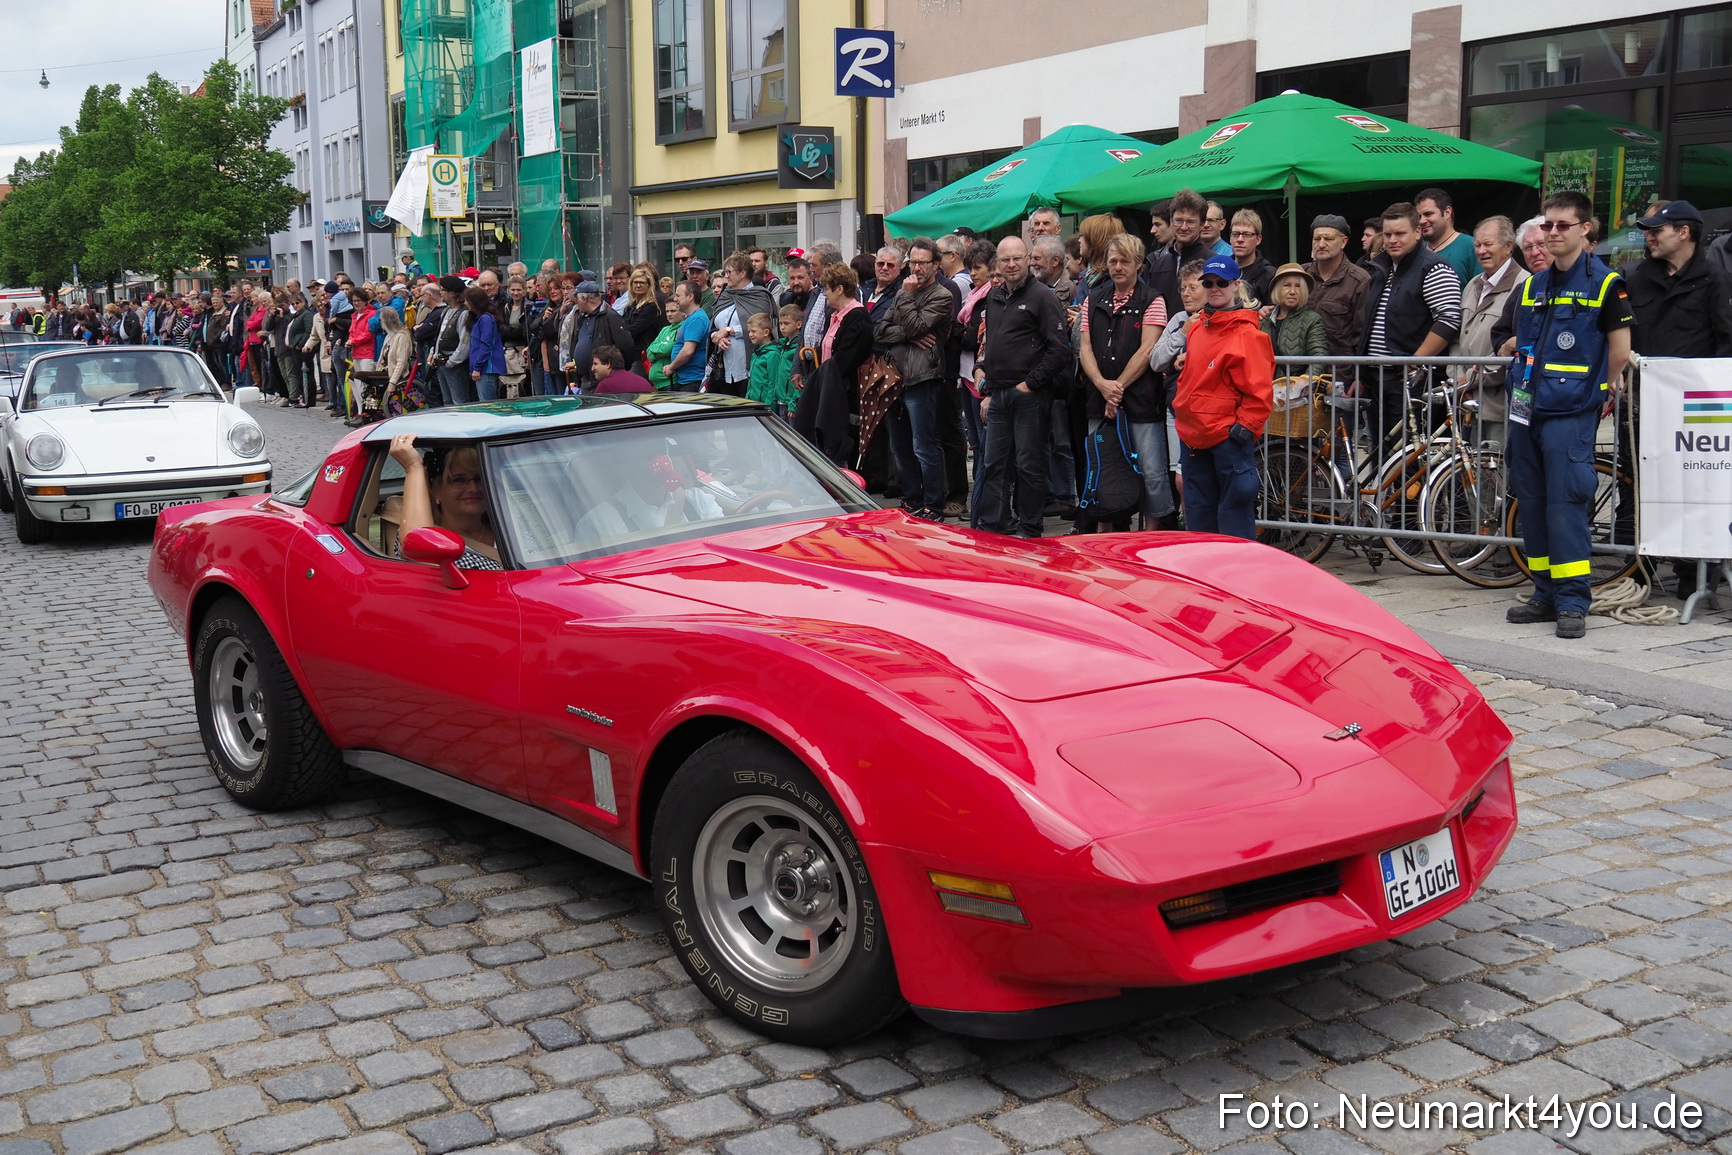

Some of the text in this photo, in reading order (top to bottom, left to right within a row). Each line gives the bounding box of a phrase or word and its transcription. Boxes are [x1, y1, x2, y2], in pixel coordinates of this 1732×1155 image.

[900, 110, 946, 129] Unterer Markt 15
[1351, 142, 1463, 155] Lammsbräu
[1353, 135, 1433, 144] Neumarkter
[801, 143, 821, 169] G2
[439, 165, 451, 180] H
[1132, 154, 1236, 178] Lammsbräu
[1550, 168, 1570, 176] Wald-
[54, 399, 68, 407] 146
[1675, 430, 1732, 453] Neu
[1683, 460, 1732, 470] einkaufe
[125, 504, 141, 517] FO
[733, 770, 875, 952] GRABBER HP
[1402, 845, 1416, 875] N
[1389, 858, 1458, 913] GE 100H
[662, 857, 789, 1026] GENERAL
